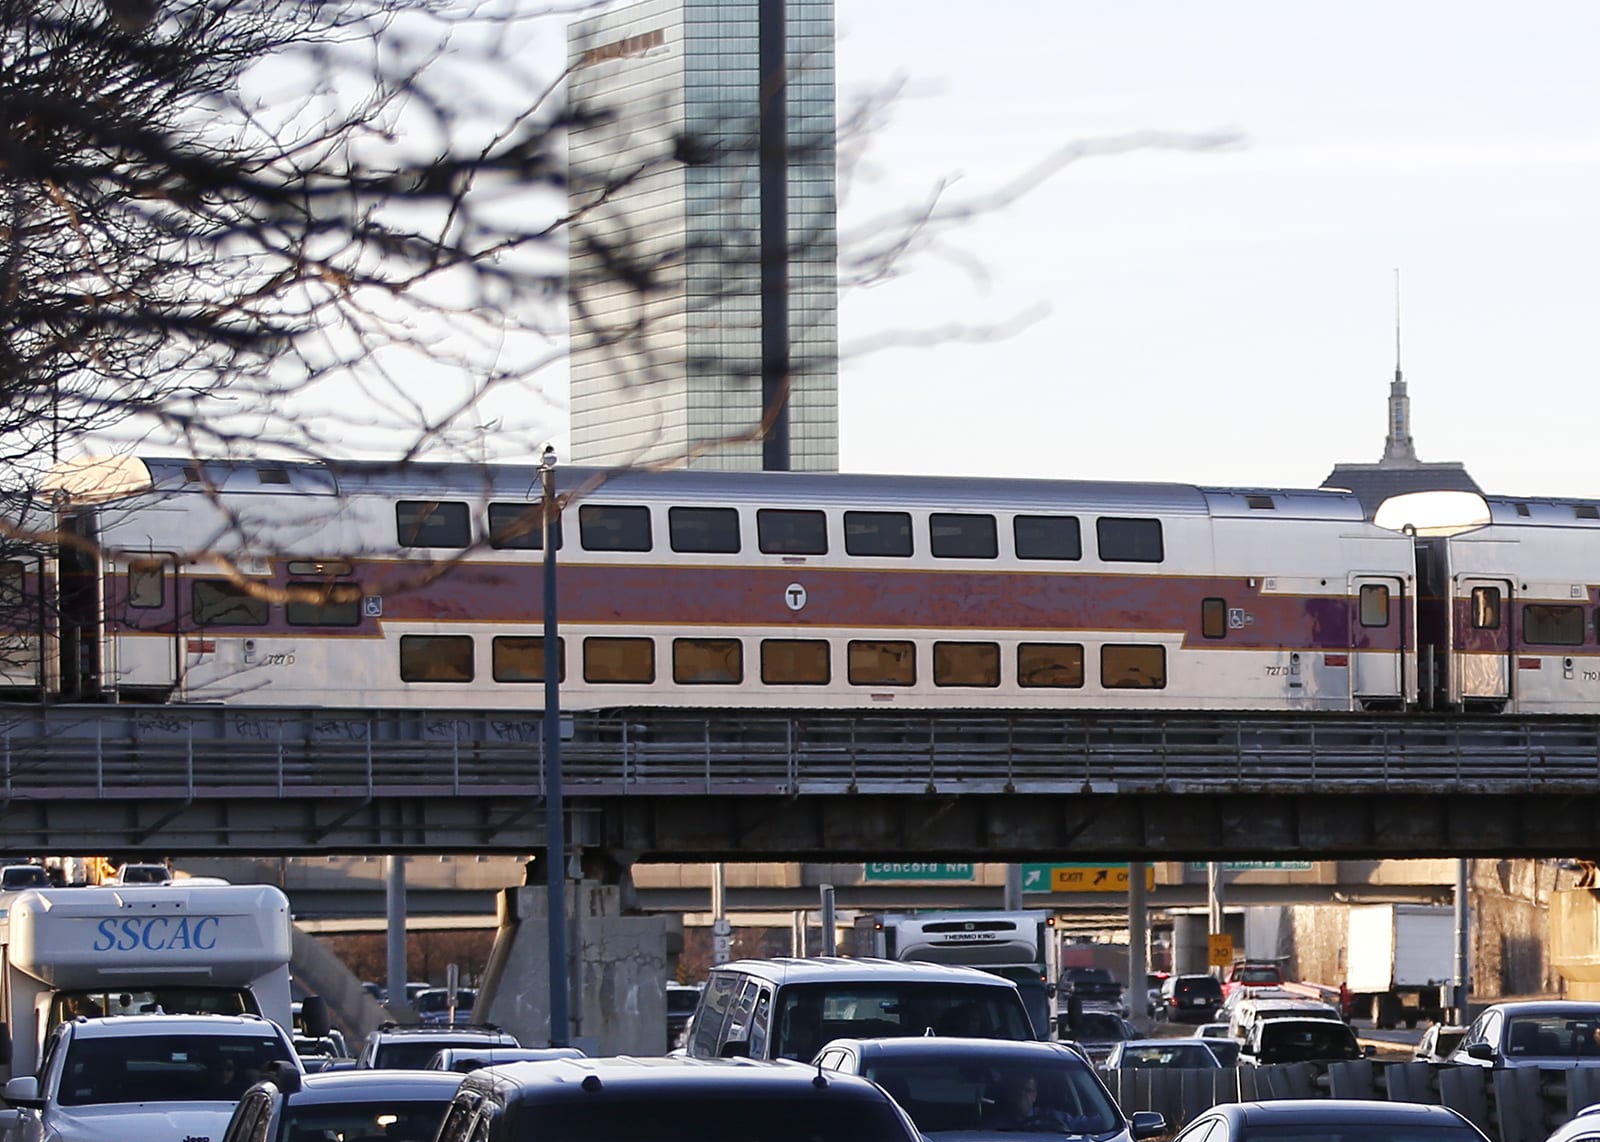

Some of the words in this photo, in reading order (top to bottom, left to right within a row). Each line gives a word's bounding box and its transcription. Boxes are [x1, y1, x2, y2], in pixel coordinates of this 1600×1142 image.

[871, 862, 937, 873] Concord
[1059, 872, 1084, 882] EXIT
[93, 917, 220, 951] SSCAC
